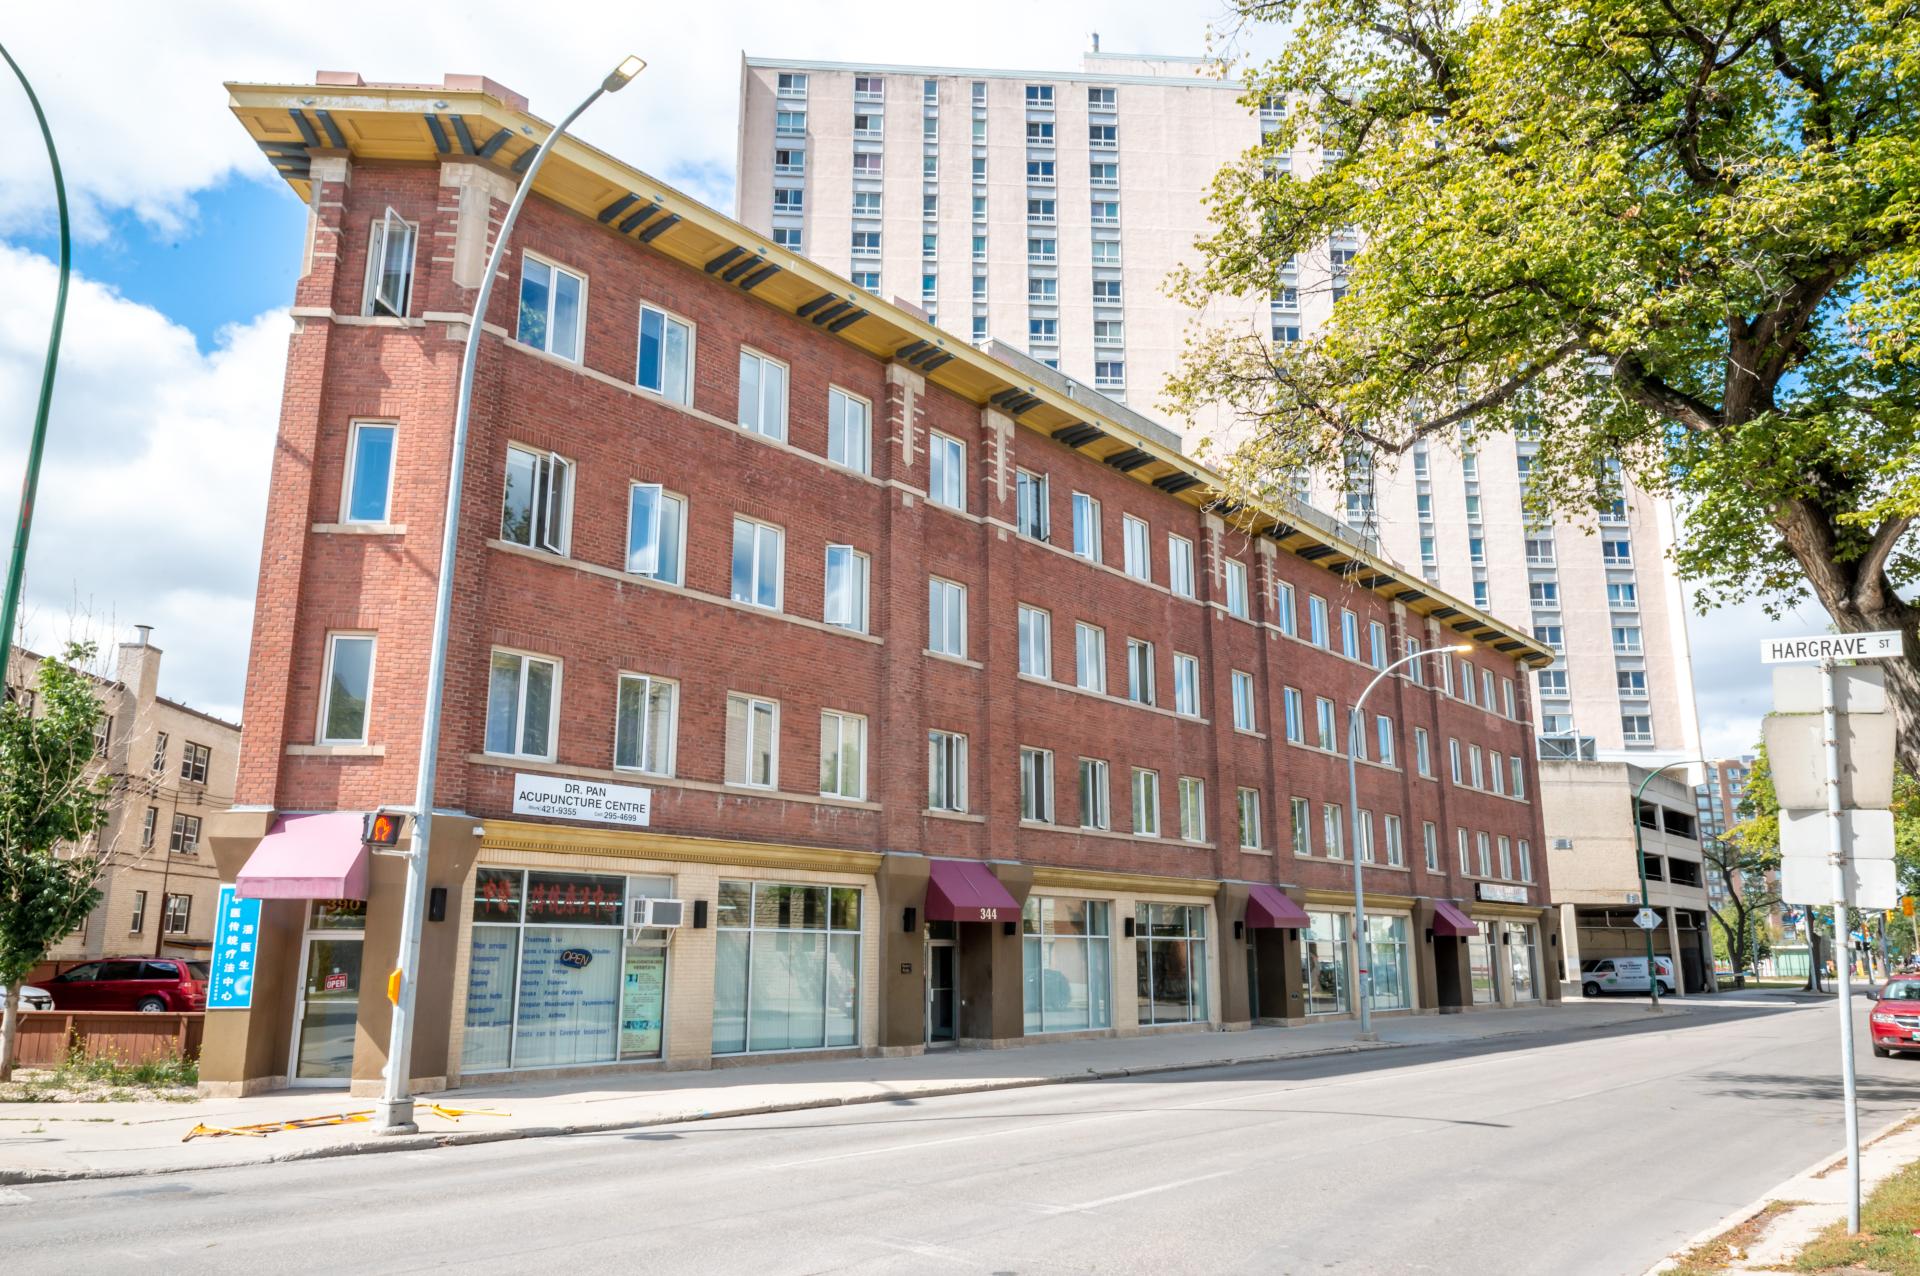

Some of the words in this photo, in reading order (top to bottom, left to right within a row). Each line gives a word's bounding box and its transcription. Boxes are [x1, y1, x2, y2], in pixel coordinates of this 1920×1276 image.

[1772, 638, 1867, 659] HARGRAVE
[1879, 639, 1890, 648] ST
[564, 783, 583, 795] DR.
[586, 786, 607, 797] PAN
[519, 791, 602, 809] ACUPUNCTURE
[605, 800, 646, 814] CENTRE
[541, 805, 577, 816] 421-9355
[603, 811, 637, 822] 295-4699
[980, 908, 997, 920] 344
[326, 980, 346, 989] OPEN
